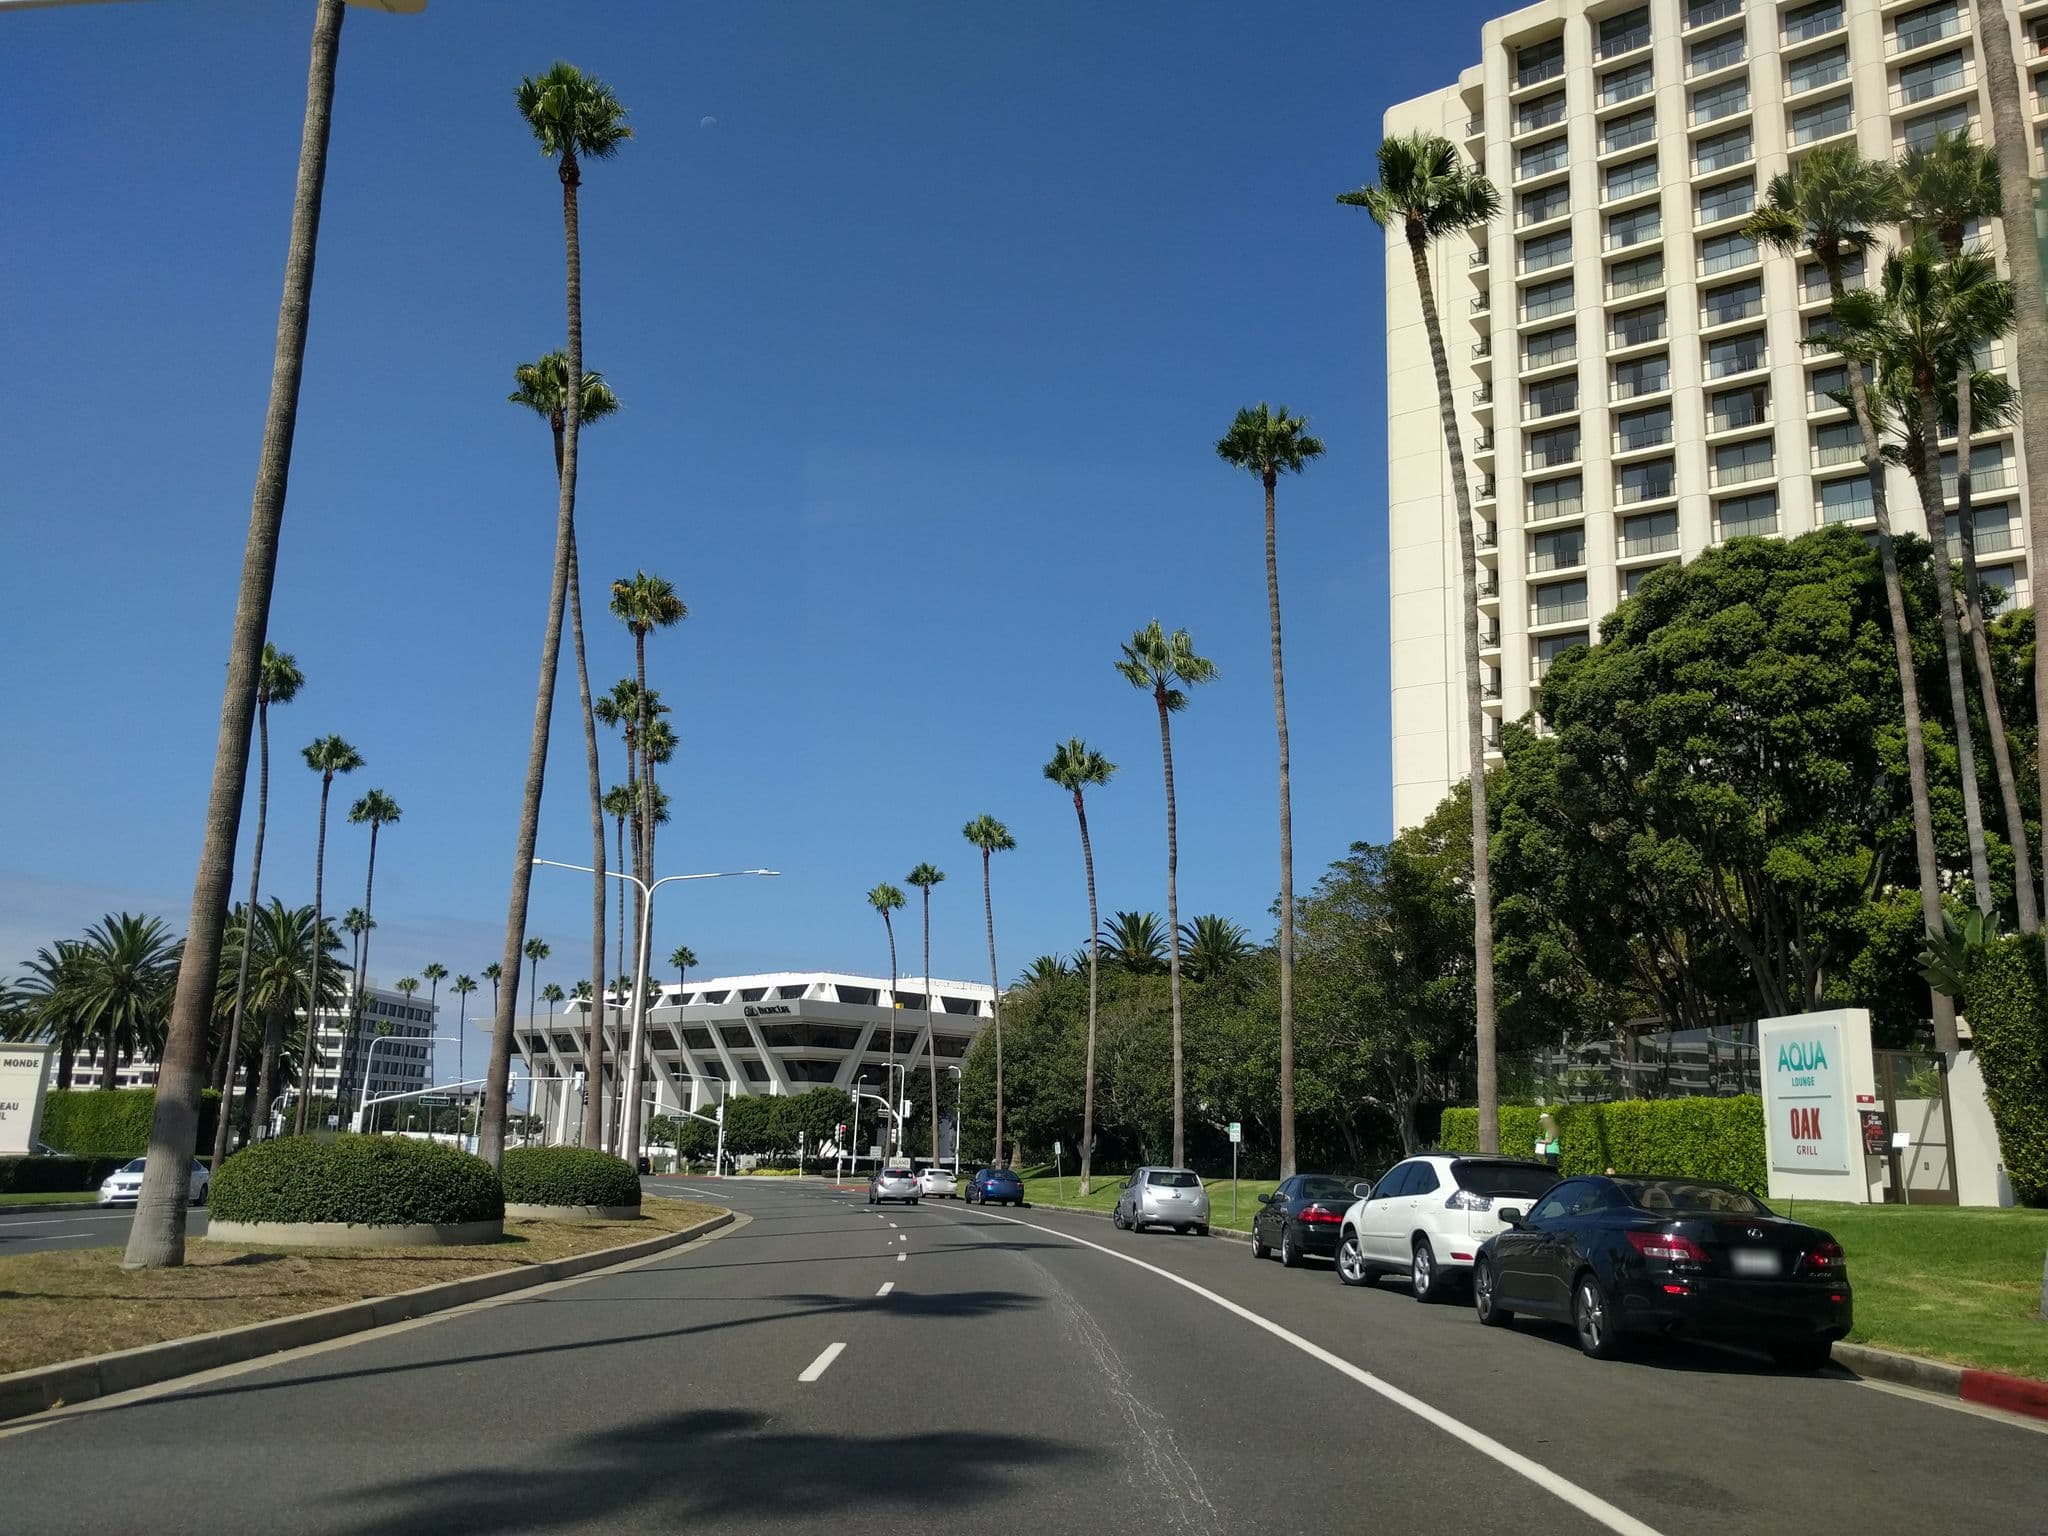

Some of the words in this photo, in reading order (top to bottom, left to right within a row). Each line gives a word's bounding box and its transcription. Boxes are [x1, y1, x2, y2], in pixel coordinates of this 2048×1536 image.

[1778, 1040, 1828, 1072] AQUA
[3, 1059, 39, 1068] MONDE
[1792, 1076, 1815, 1087] LOUNGE
[0, 1102, 19, 1111] EAU
[1790, 1107, 1822, 1140] OAK
[1796, 1145, 1818, 1155] GRILL
